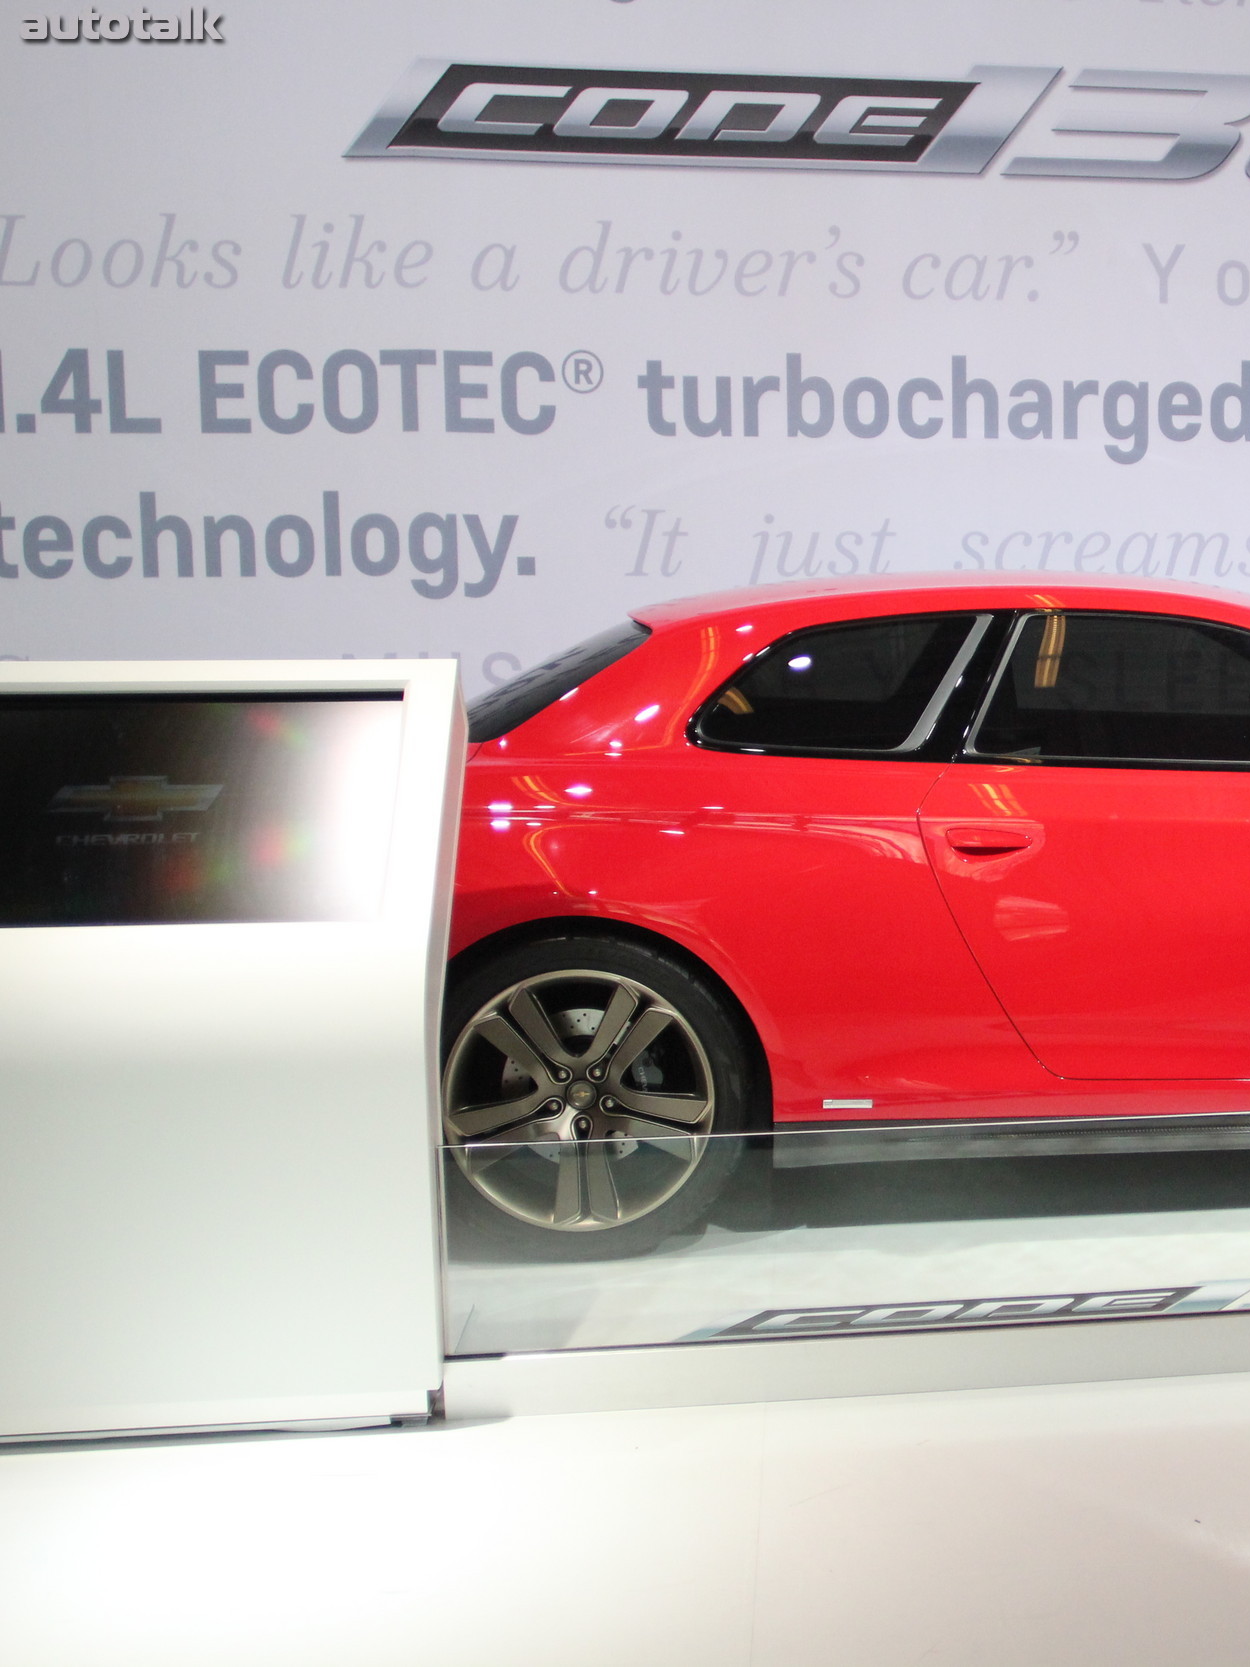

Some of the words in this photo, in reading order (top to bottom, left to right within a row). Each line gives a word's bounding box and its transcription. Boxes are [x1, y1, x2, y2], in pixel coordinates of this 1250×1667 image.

[437, 82, 943, 146] CODE
[0, 213, 242, 290] Looks
[281, 214, 434, 290] like
[470, 243, 520, 293] a
[558, 220, 866, 299] driver’s
[901, 230, 1081, 302] car.”
[604, 505, 690, 578] “It
[748, 512, 899, 586] just
[55, 832, 201, 847] CHEVROLET
